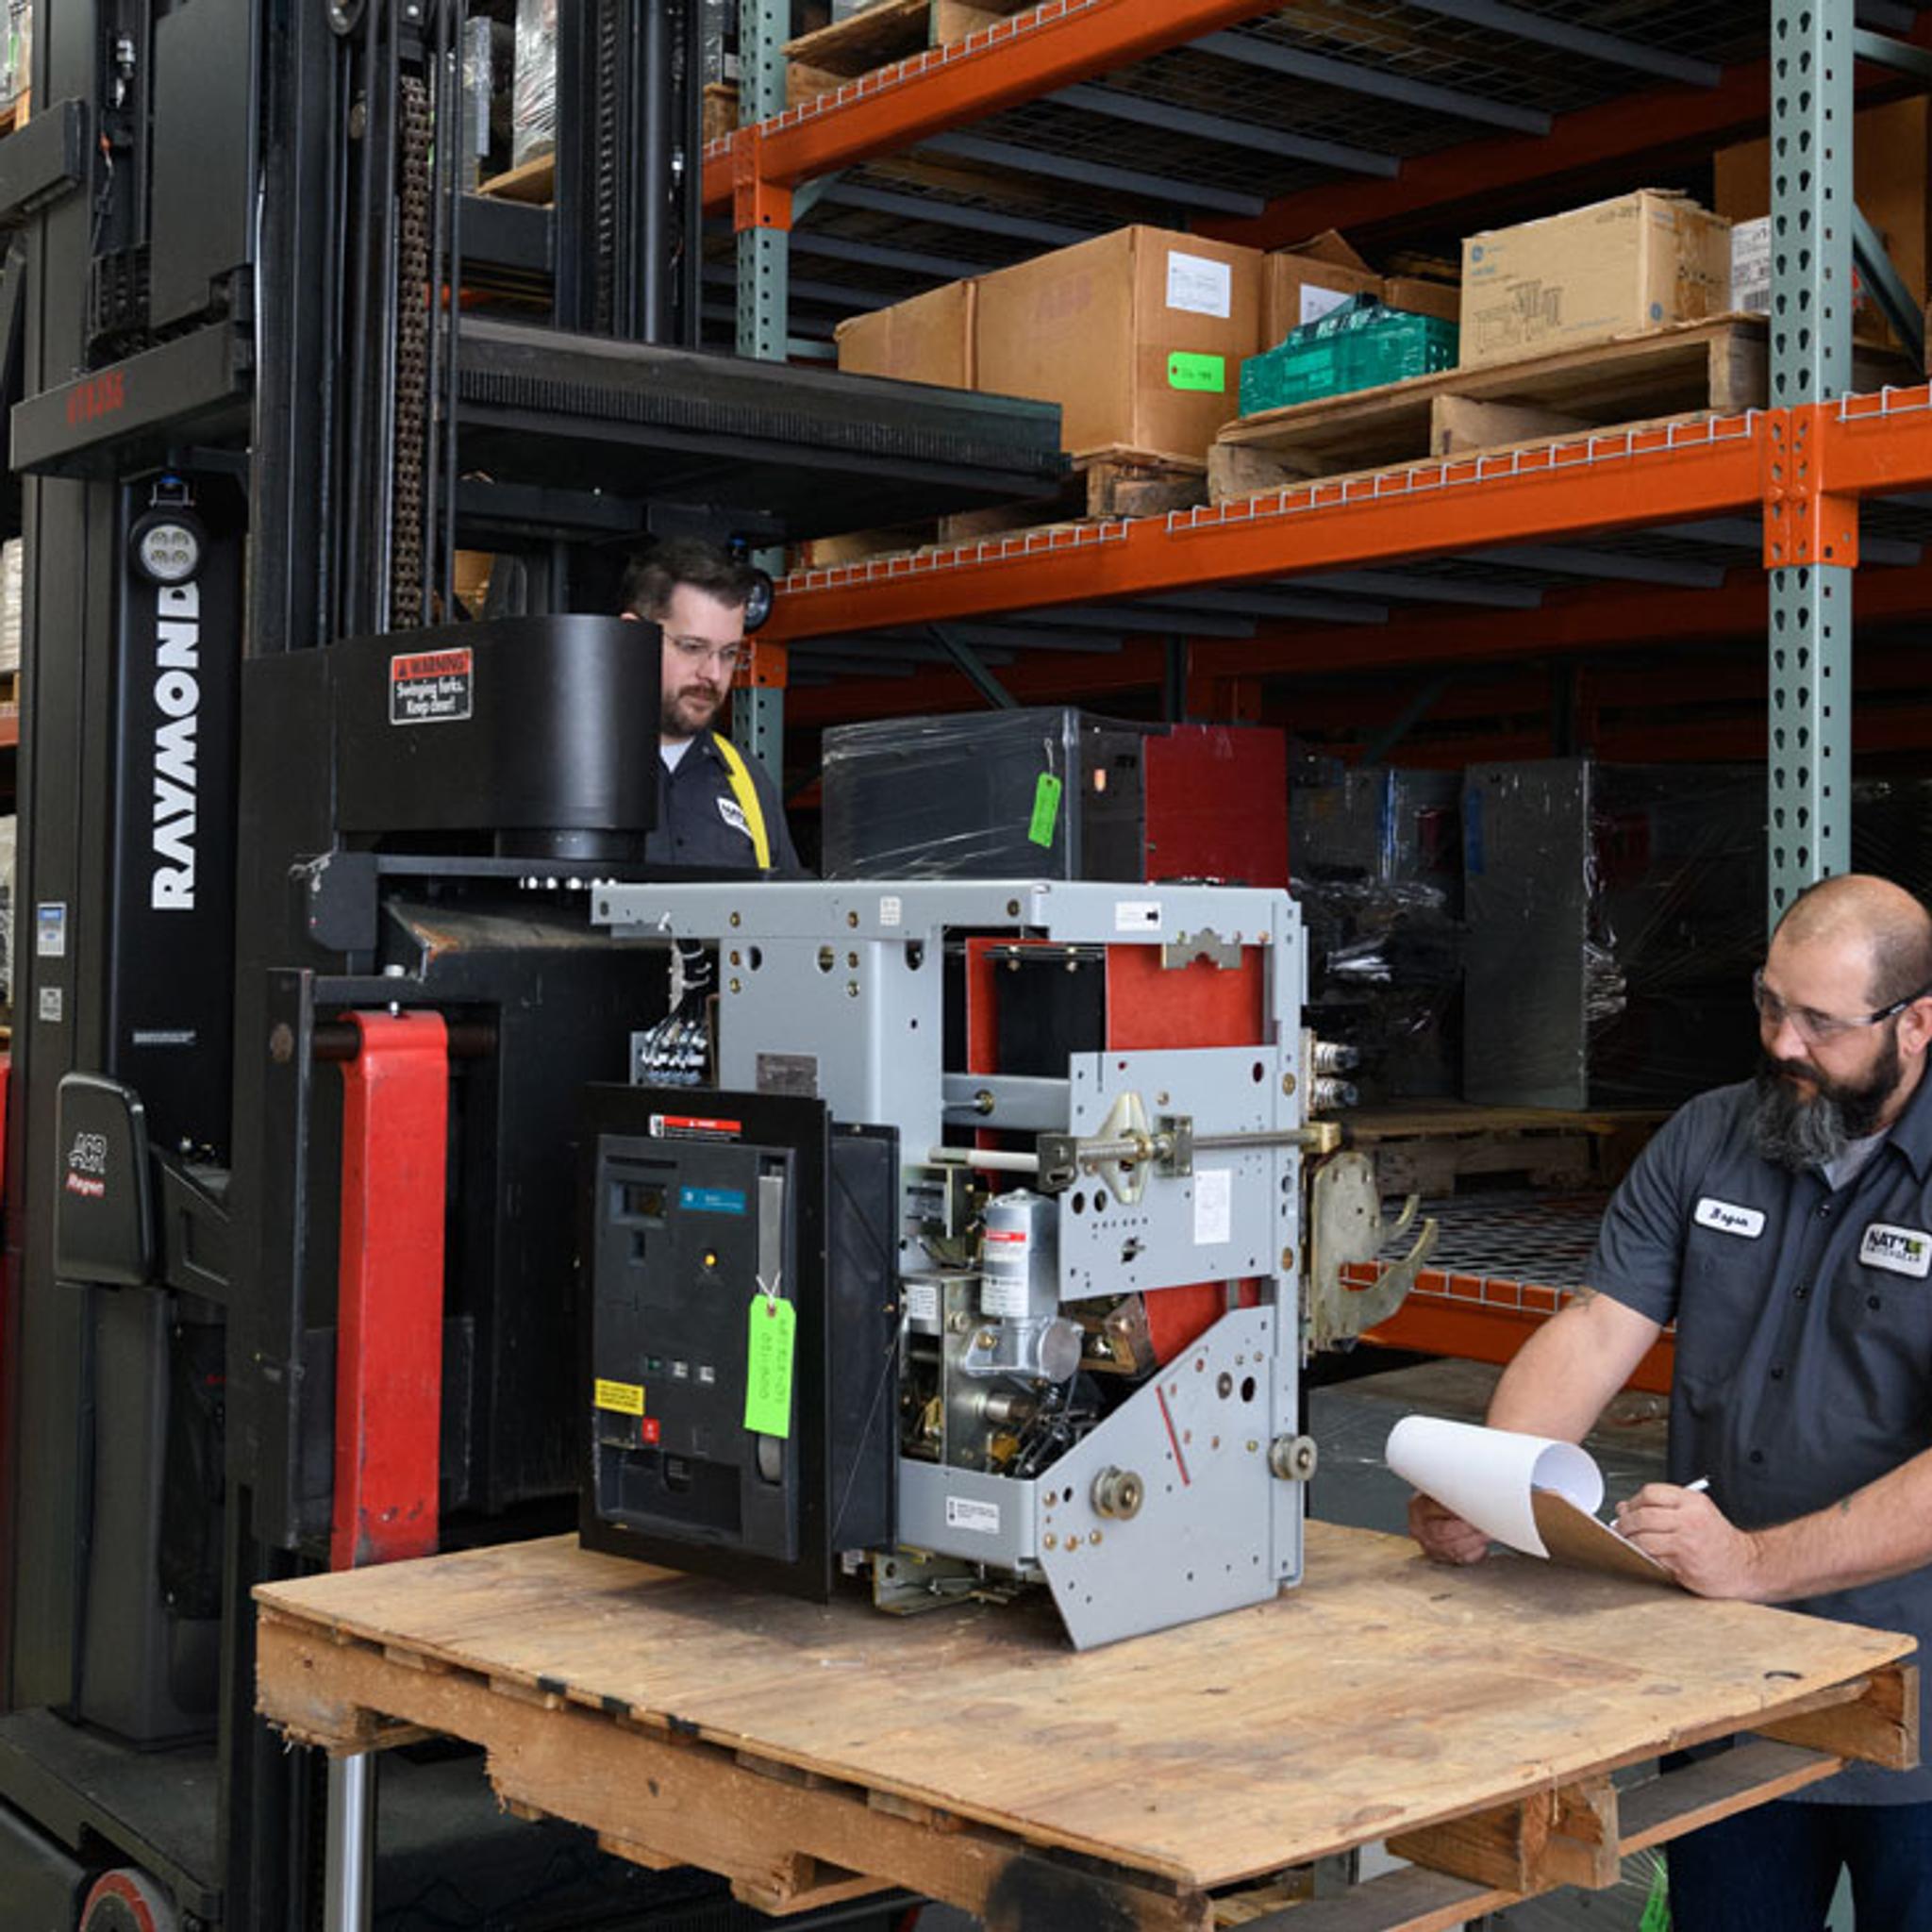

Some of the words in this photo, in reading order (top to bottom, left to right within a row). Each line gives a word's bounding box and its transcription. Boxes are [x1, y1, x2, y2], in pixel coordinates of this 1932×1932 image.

[410, 653, 465, 674] WARNING
[407, 699, 429, 717] Keep
[152, 581, 199, 910] RAYMOND
